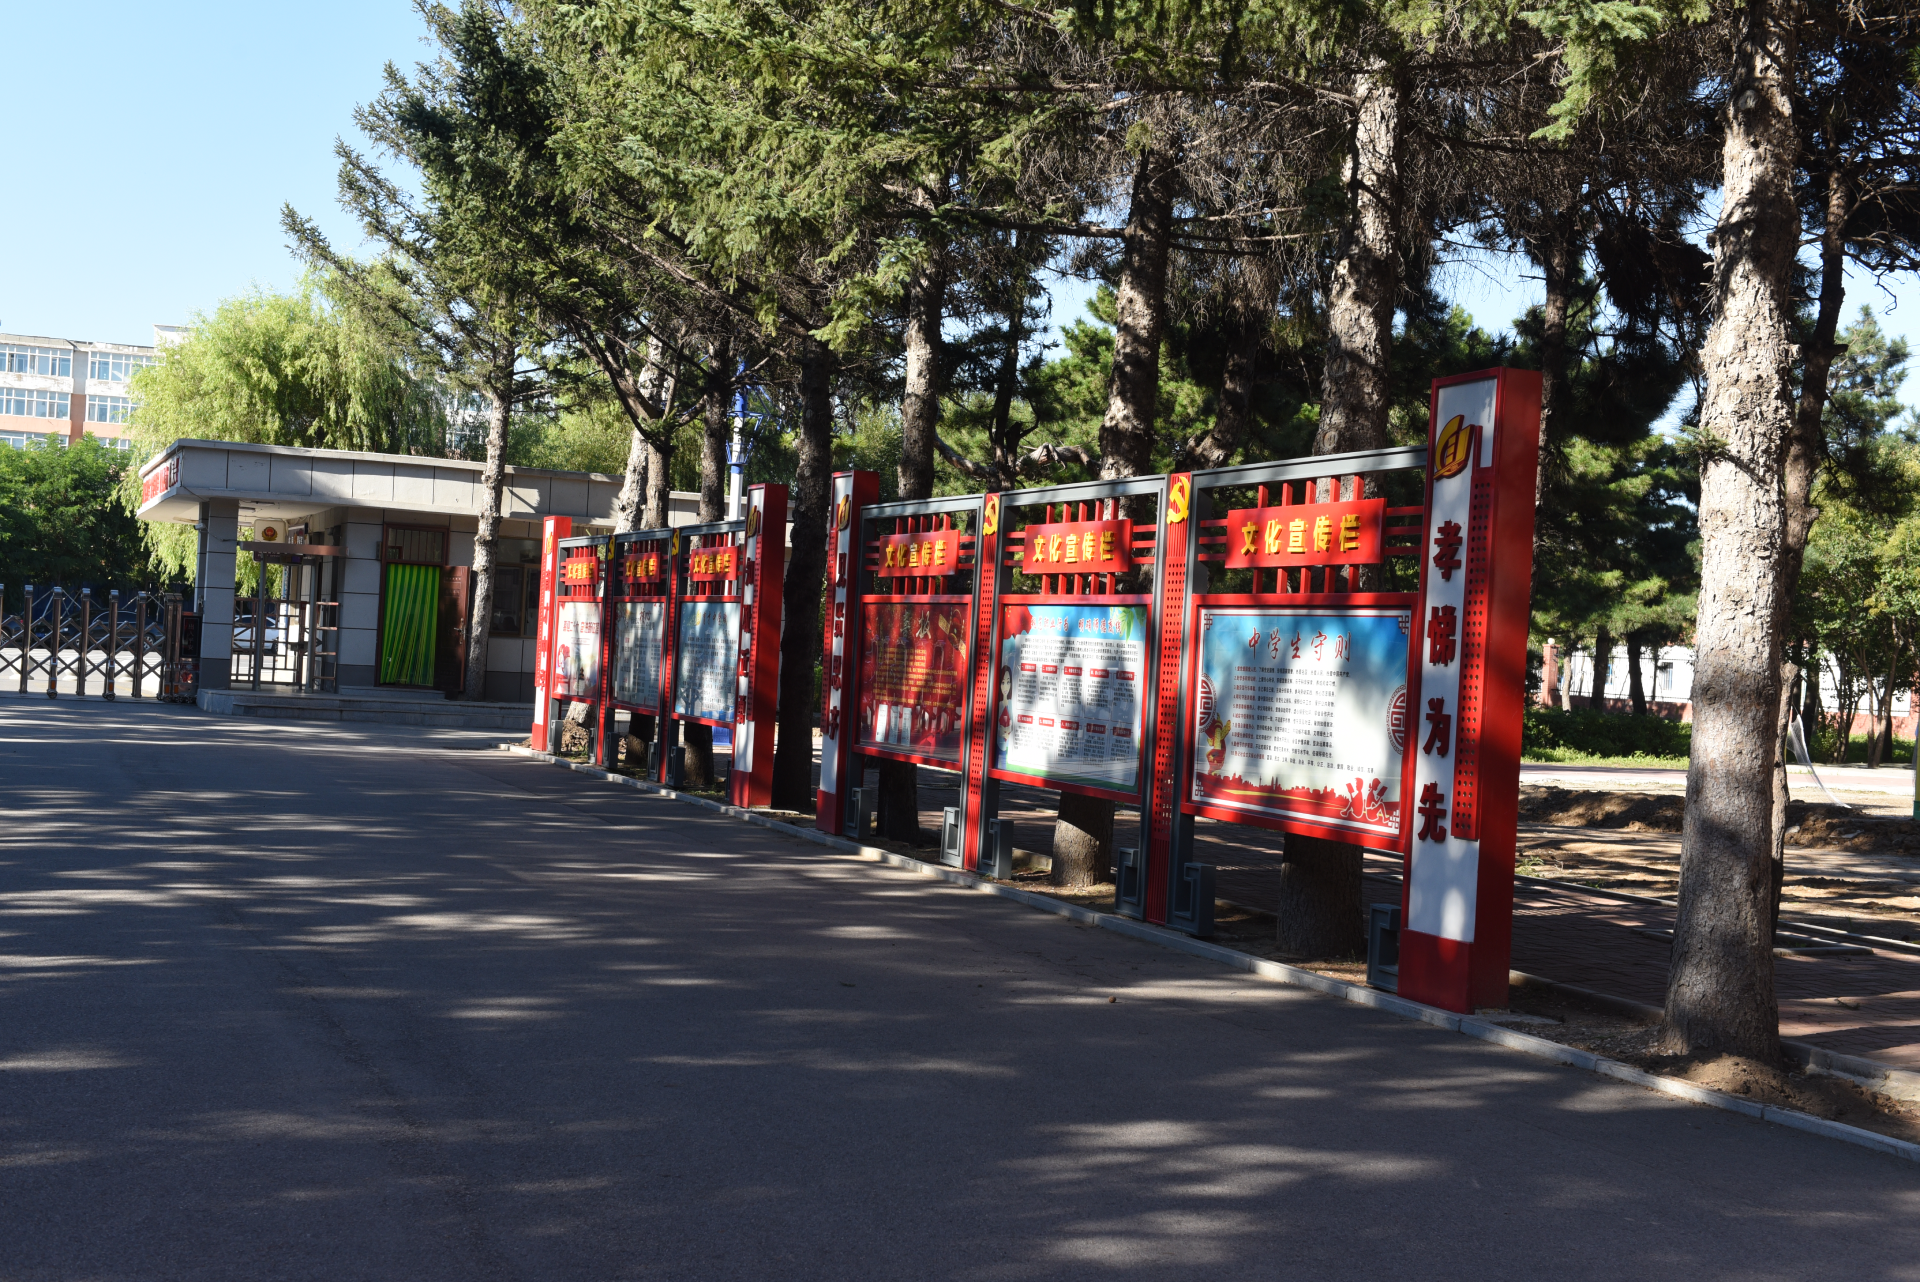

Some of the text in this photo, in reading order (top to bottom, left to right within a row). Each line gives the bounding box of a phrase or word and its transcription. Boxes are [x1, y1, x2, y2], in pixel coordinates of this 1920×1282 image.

[1032, 531, 1115, 563] 文化宣传栏
[1241, 515, 1361, 555] 文化宣传栏
[693, 553, 732, 574] 文化宣传栏
[885, 540, 946, 567] 文化宣传栏
[567, 562, 594, 579] 文化宣传栏
[625, 558, 656, 578] 文化宣传栏
[1078, 617, 1123, 634] 明确师德底线
[1248, 627, 1351, 662] 中学生守则
[1418, 521, 1462, 841] 孝悌为先
